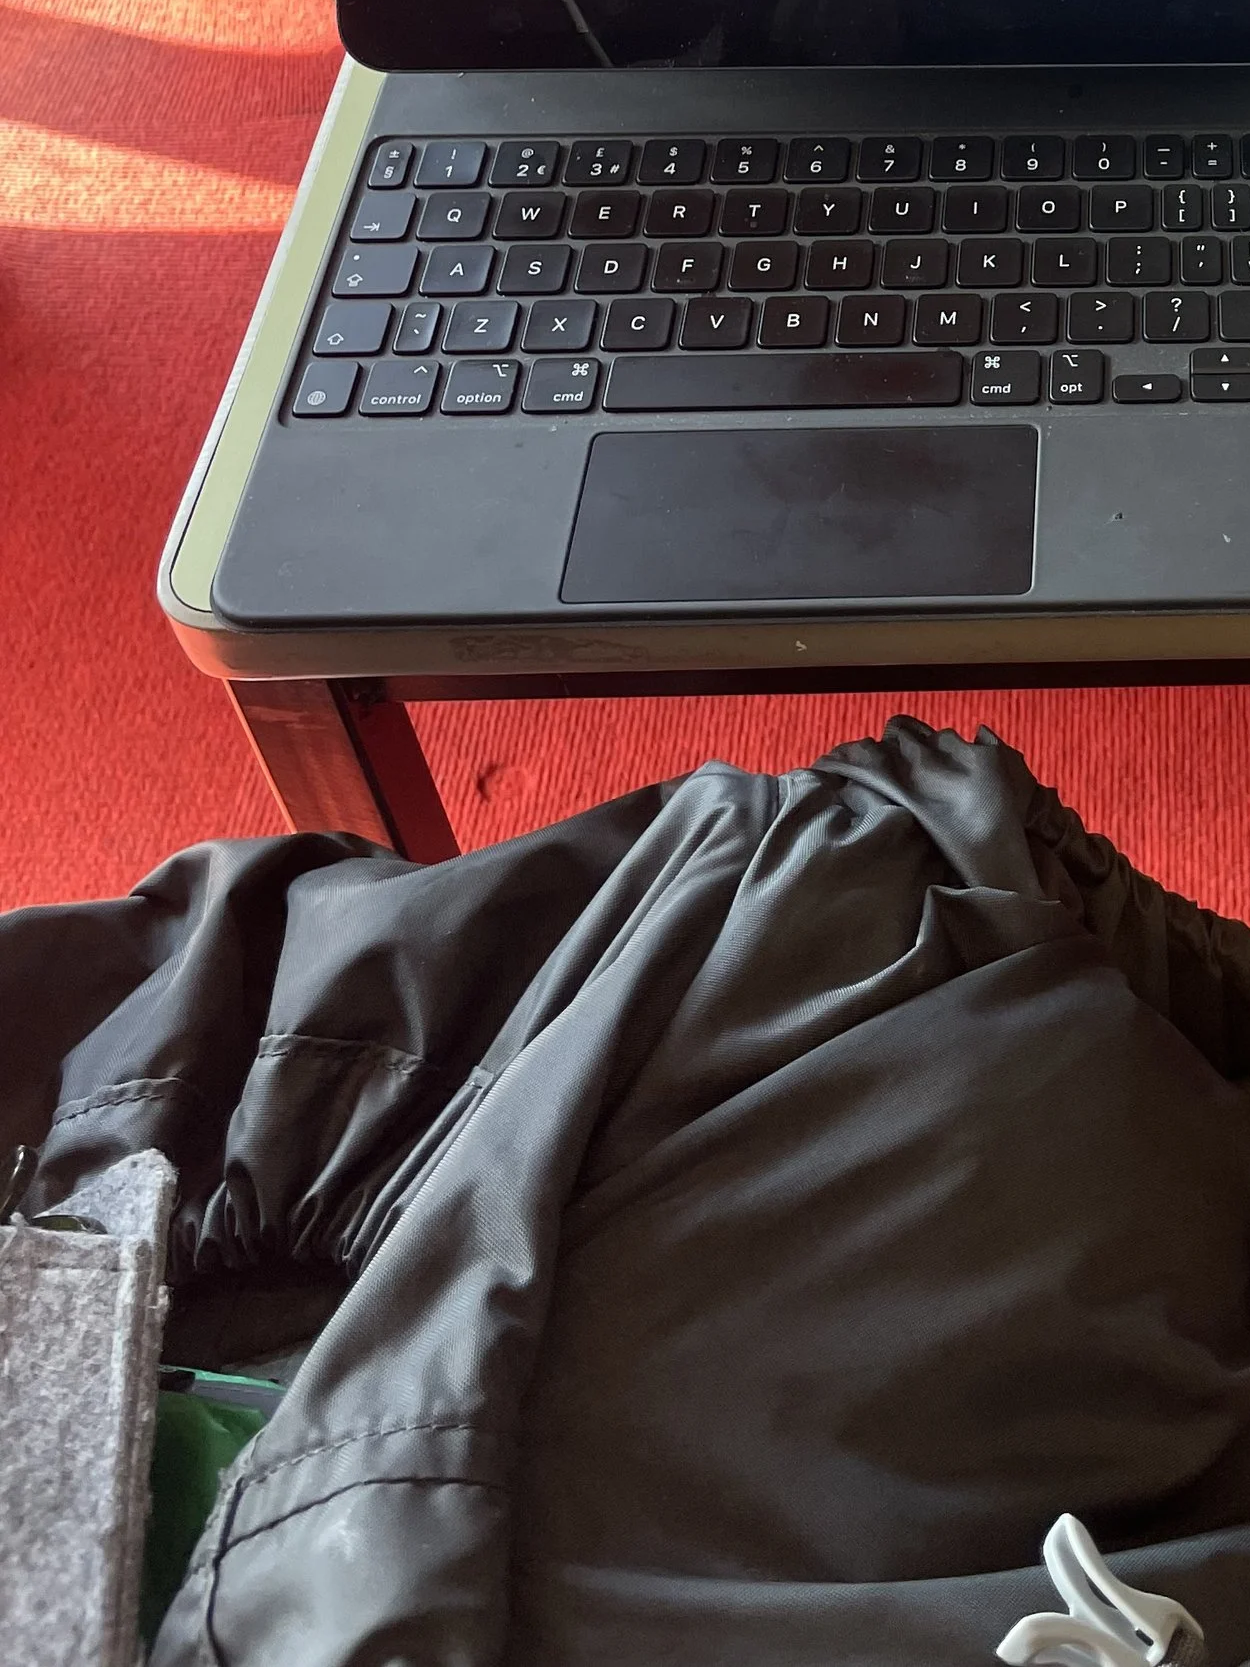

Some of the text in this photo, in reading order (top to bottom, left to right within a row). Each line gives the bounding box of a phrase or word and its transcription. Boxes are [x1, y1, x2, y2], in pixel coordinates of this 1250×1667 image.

[516, 164, 529, 177] 2
[590, 163, 603, 176] 3
[663, 162, 676, 175] 4
[737, 161, 749, 174] 5
[810, 160, 822, 173] 6
[884, 159, 895, 172] 7
[955, 159, 967, 172] 8
[1027, 158, 1039, 171] 9
[447, 208, 462, 223] Q
[521, 207, 541, 221] W
[598, 206, 611, 220] E
[672, 205, 686, 219] R
[749, 204, 762, 218] T
[823, 203, 835, 217] Y
[895, 202, 909, 216] U
[1115, 200, 1127, 213] P
[449, 254, 1070, 276] A S D F G H J K L
[473, 311, 957, 333] Z X C V B N M
[370, 381, 1083, 405] control option cmd cmd opt
